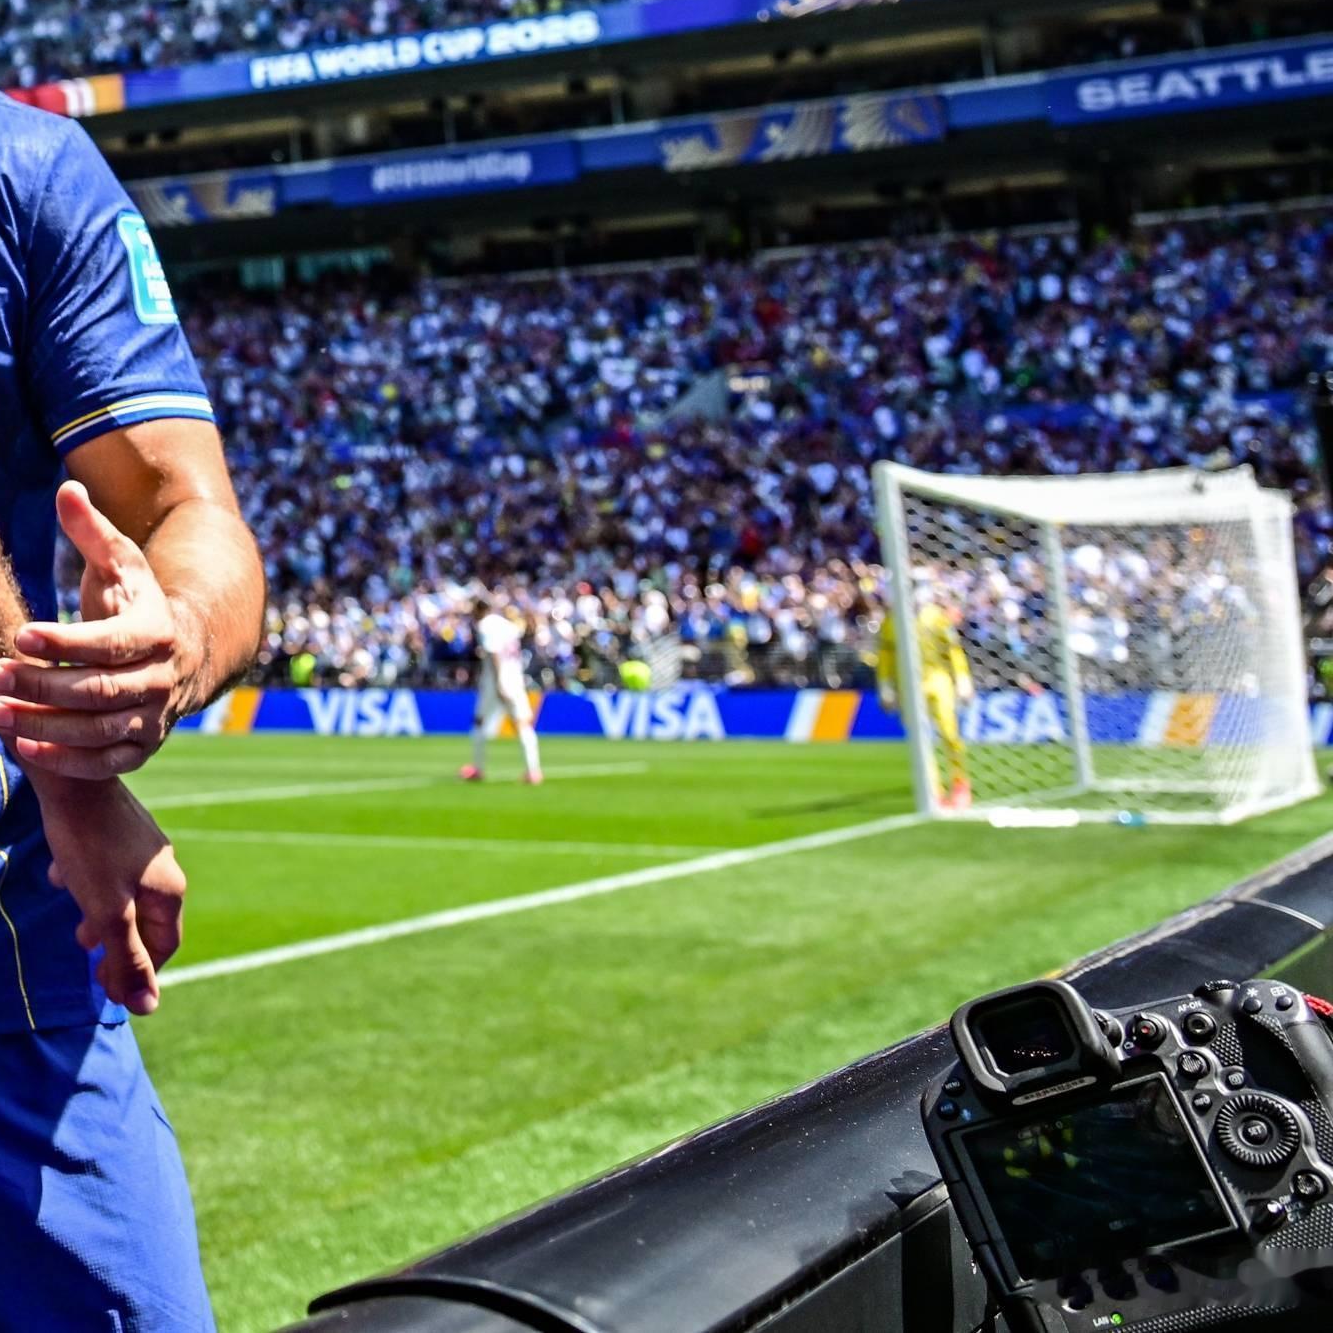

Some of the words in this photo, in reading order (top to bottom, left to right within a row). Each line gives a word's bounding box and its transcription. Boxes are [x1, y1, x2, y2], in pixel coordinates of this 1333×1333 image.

[249, 51, 315, 89] FIFA
[312, 36, 422, 80] WORLD
[422, 26, 485, 65] CUP
[486, 10, 601, 56] 2026
[1076, 50, 1333, 112] SEATTLE
[297, 688, 425, 736] VISA
[586, 689, 727, 740] VISA
[957, 690, 1069, 743] ISA
[1177, 1000, 1203, 1013] AF-ON
[1247, 1125, 1262, 1137] SET
[1093, 1316, 1110, 1327] LAN
